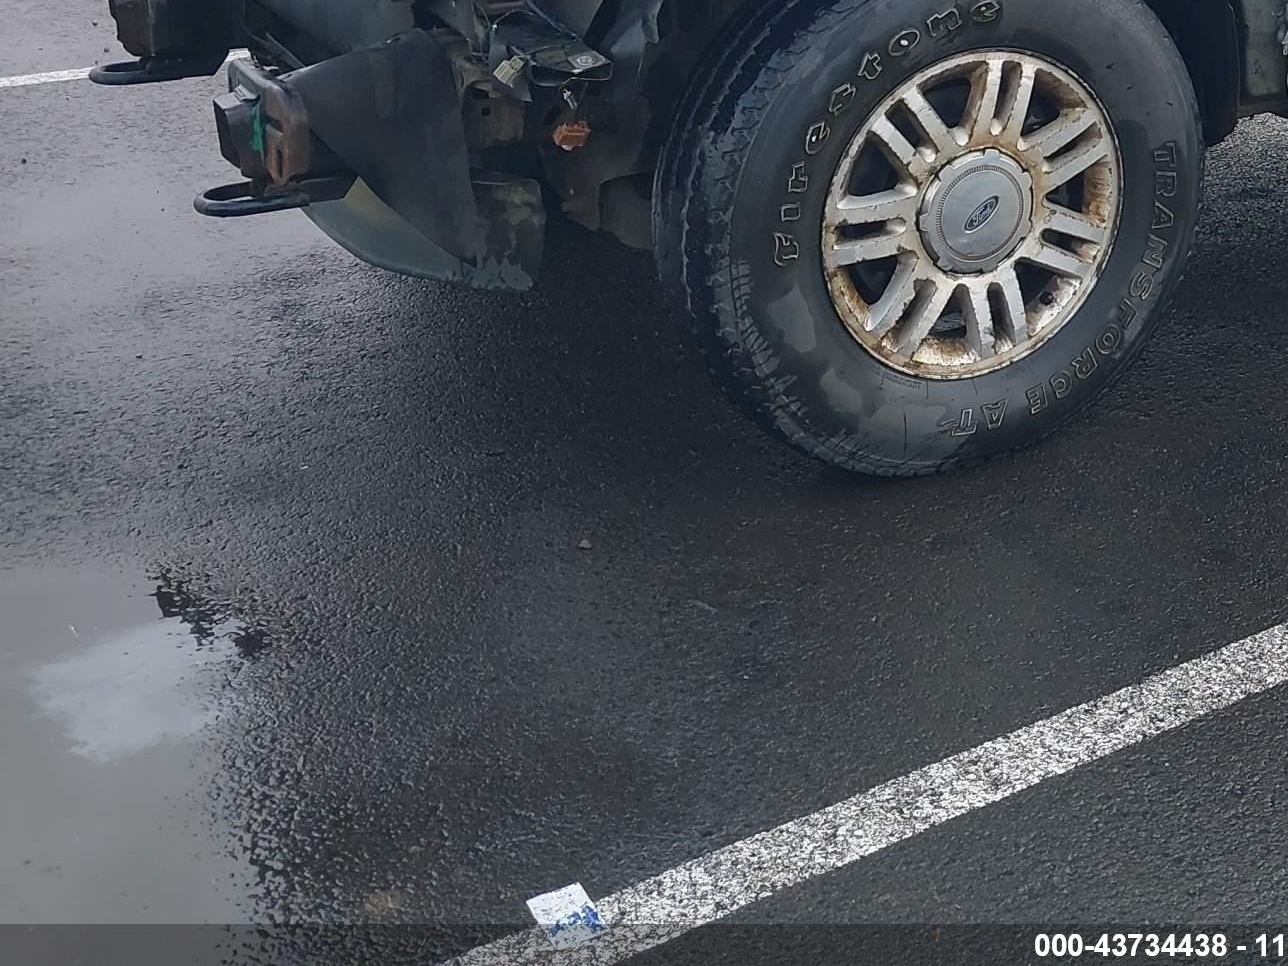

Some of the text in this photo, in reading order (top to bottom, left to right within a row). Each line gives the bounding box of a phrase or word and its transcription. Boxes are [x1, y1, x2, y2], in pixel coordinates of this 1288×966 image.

[773, 0, 1000, 267] Firestone
[1025, 140, 1178, 415] TRANSFORCE
[951, 398, 1008, 437] AT
